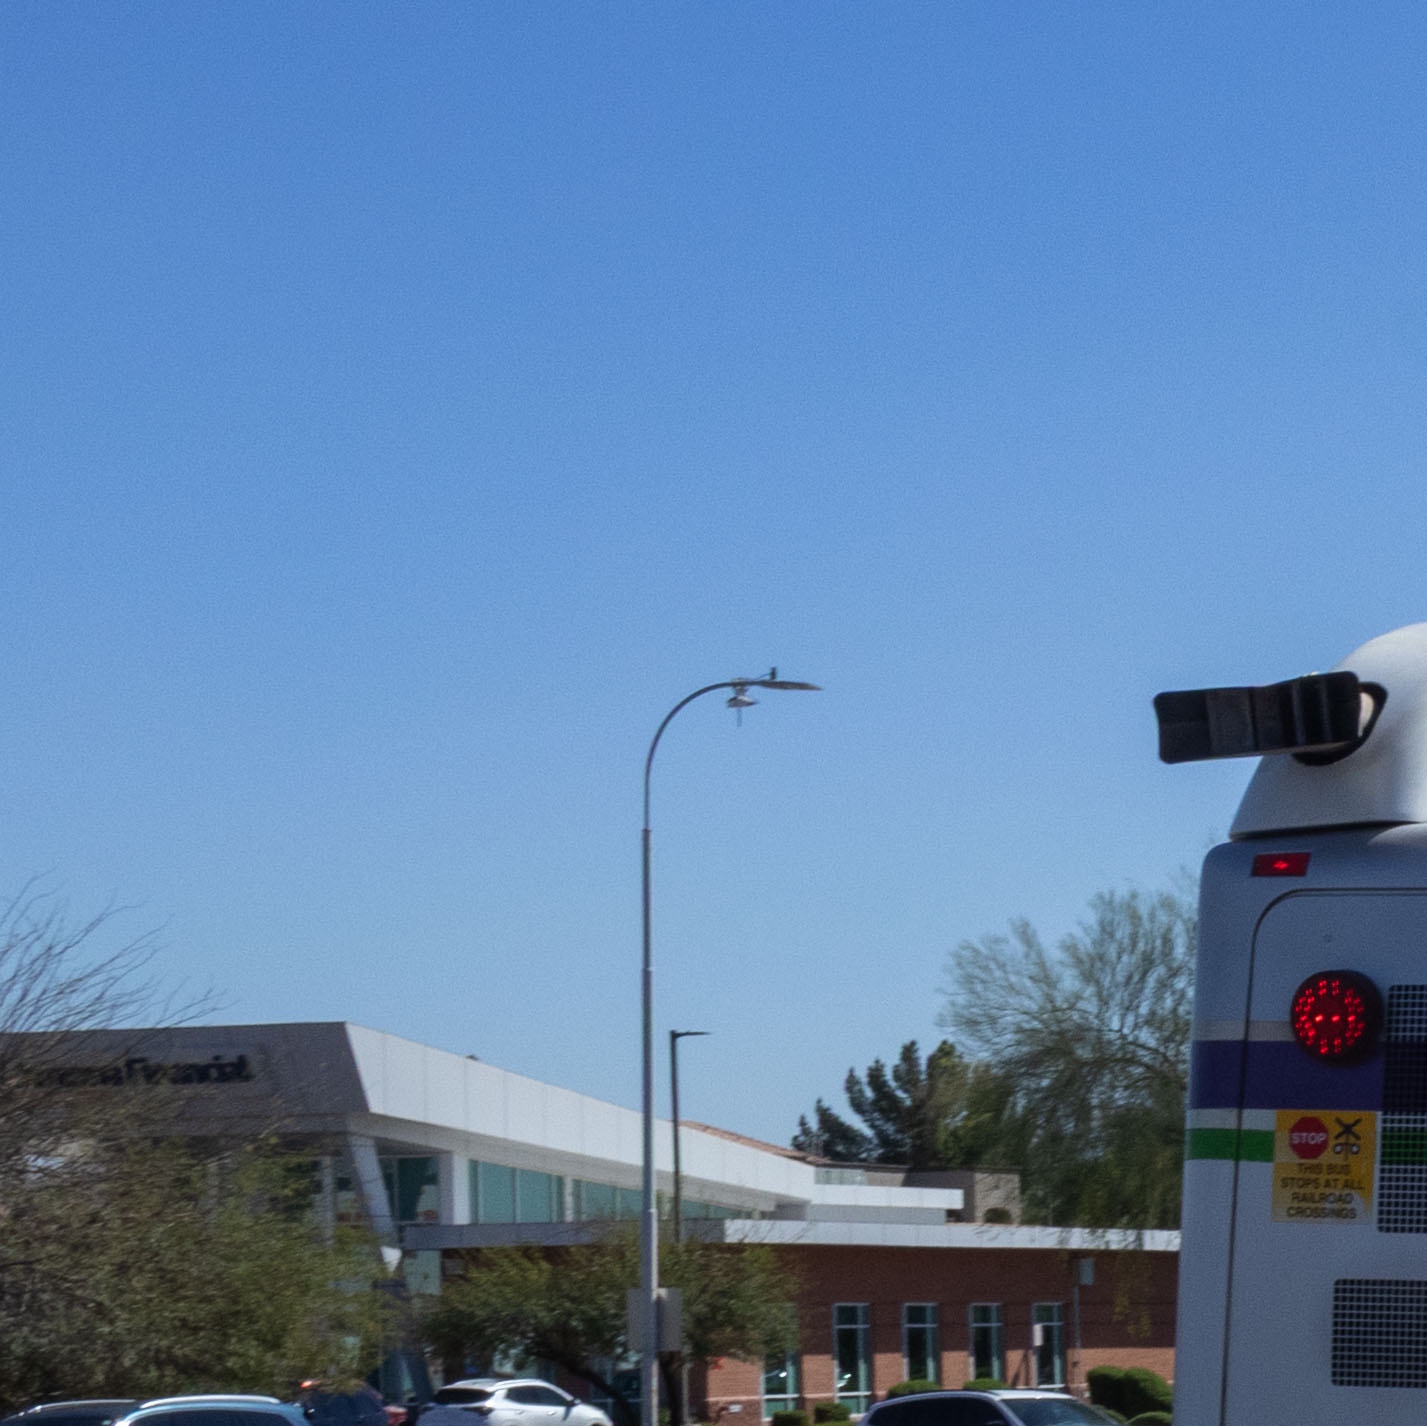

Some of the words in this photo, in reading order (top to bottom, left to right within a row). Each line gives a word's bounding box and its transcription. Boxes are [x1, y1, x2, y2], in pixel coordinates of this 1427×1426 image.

[1291, 1132, 1327, 1145] STOP
[1297, 1163, 1323, 1175] THIS
[1326, 1164, 1351, 1175] BUS
[1280, 1177, 1320, 1189] STOPS
[1323, 1178, 1339, 1189] AT
[1342, 1178, 1365, 1190] ALL
[1291, 1192, 1354, 1204] RAILROAD
[1286, 1206, 1357, 1219] CROSSINGS
